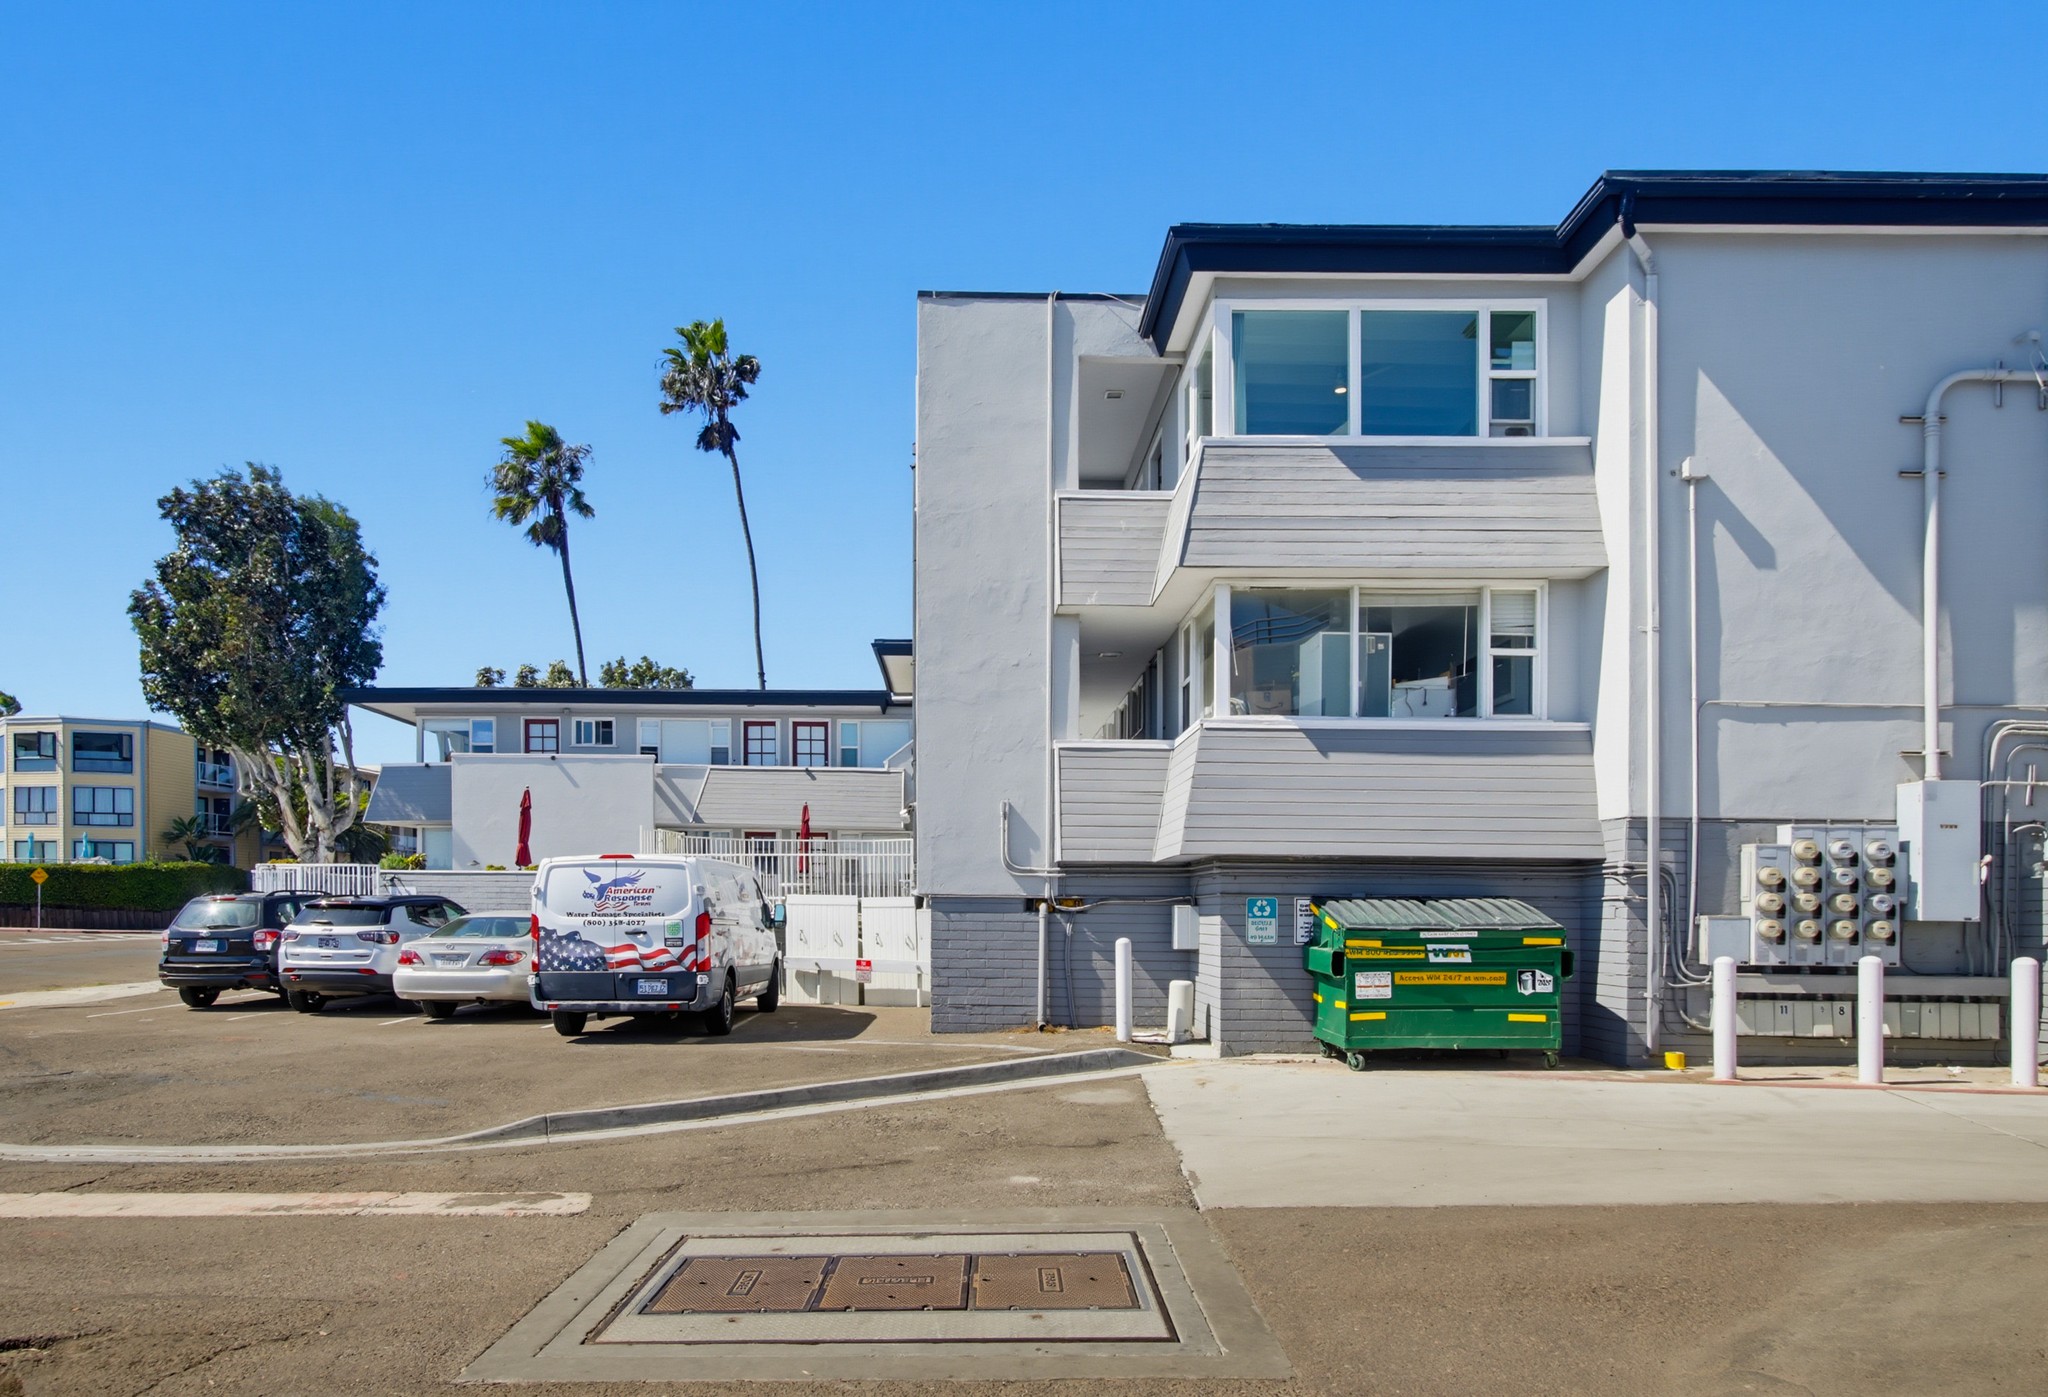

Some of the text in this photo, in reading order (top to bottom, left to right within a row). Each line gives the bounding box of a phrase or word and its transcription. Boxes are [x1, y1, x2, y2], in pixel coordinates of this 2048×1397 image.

[606, 886, 655, 895] American
[604, 894, 652, 902] Response
[1399, 974, 1424, 982] Access
[1780, 1005, 1788, 1014] 11
[1838, 1006, 1845, 1015] 8
